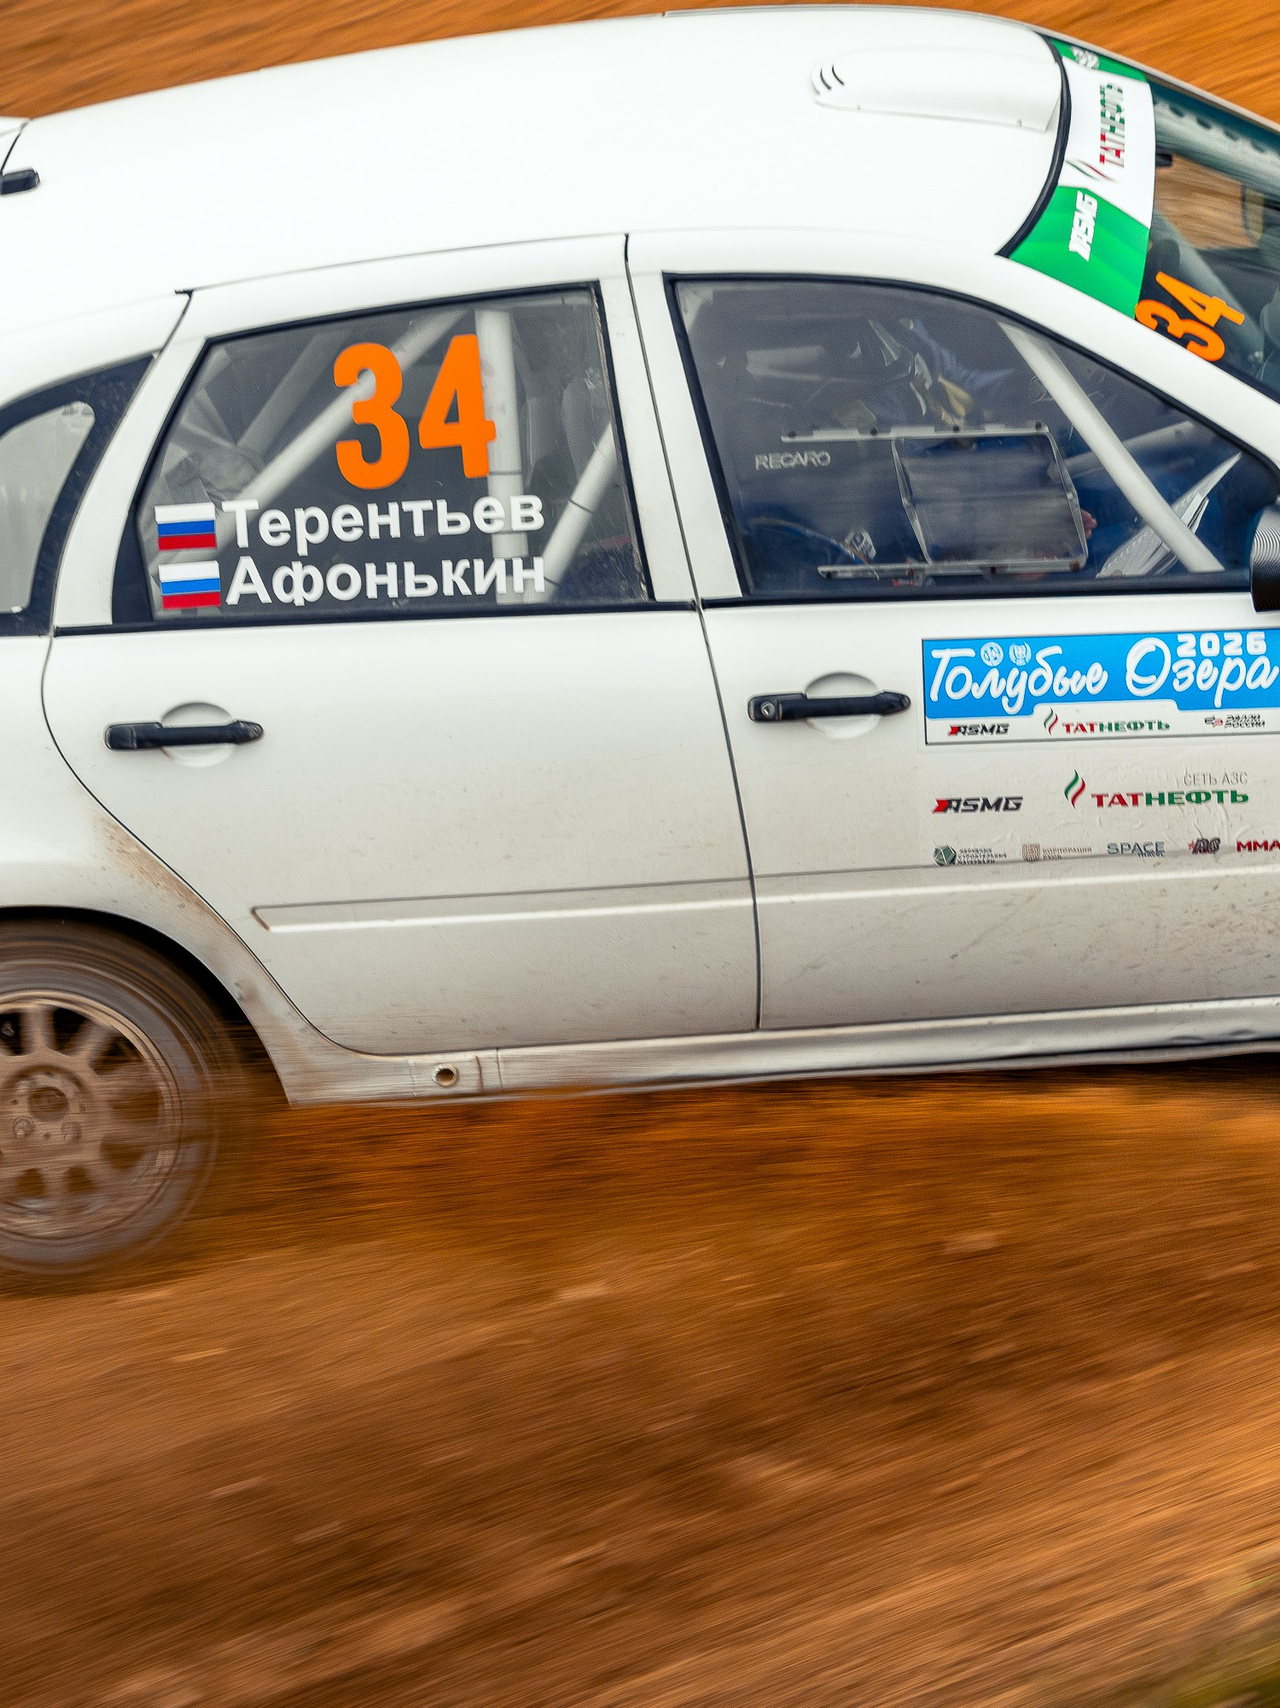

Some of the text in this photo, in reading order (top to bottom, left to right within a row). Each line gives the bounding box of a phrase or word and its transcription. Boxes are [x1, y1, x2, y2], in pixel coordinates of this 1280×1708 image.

[1135, 271, 1245, 362] 34
[333, 333, 497, 490] 34
[754, 450, 831, 471] RECARO
[222, 495, 546, 556] Терентьев
[225, 556, 546, 607] Афонькин
[1176, 631, 1268, 657] 2026
[930, 637, 1280, 715] Голубые Озера
[1062, 719, 1171, 734] ТАТНЕФТЬ
[1183, 771, 1249, 787] СЕТЬ АЗС
[1091, 789, 1250, 808] ТАТНЕФТЬ
[1107, 841, 1165, 855] SPACE
